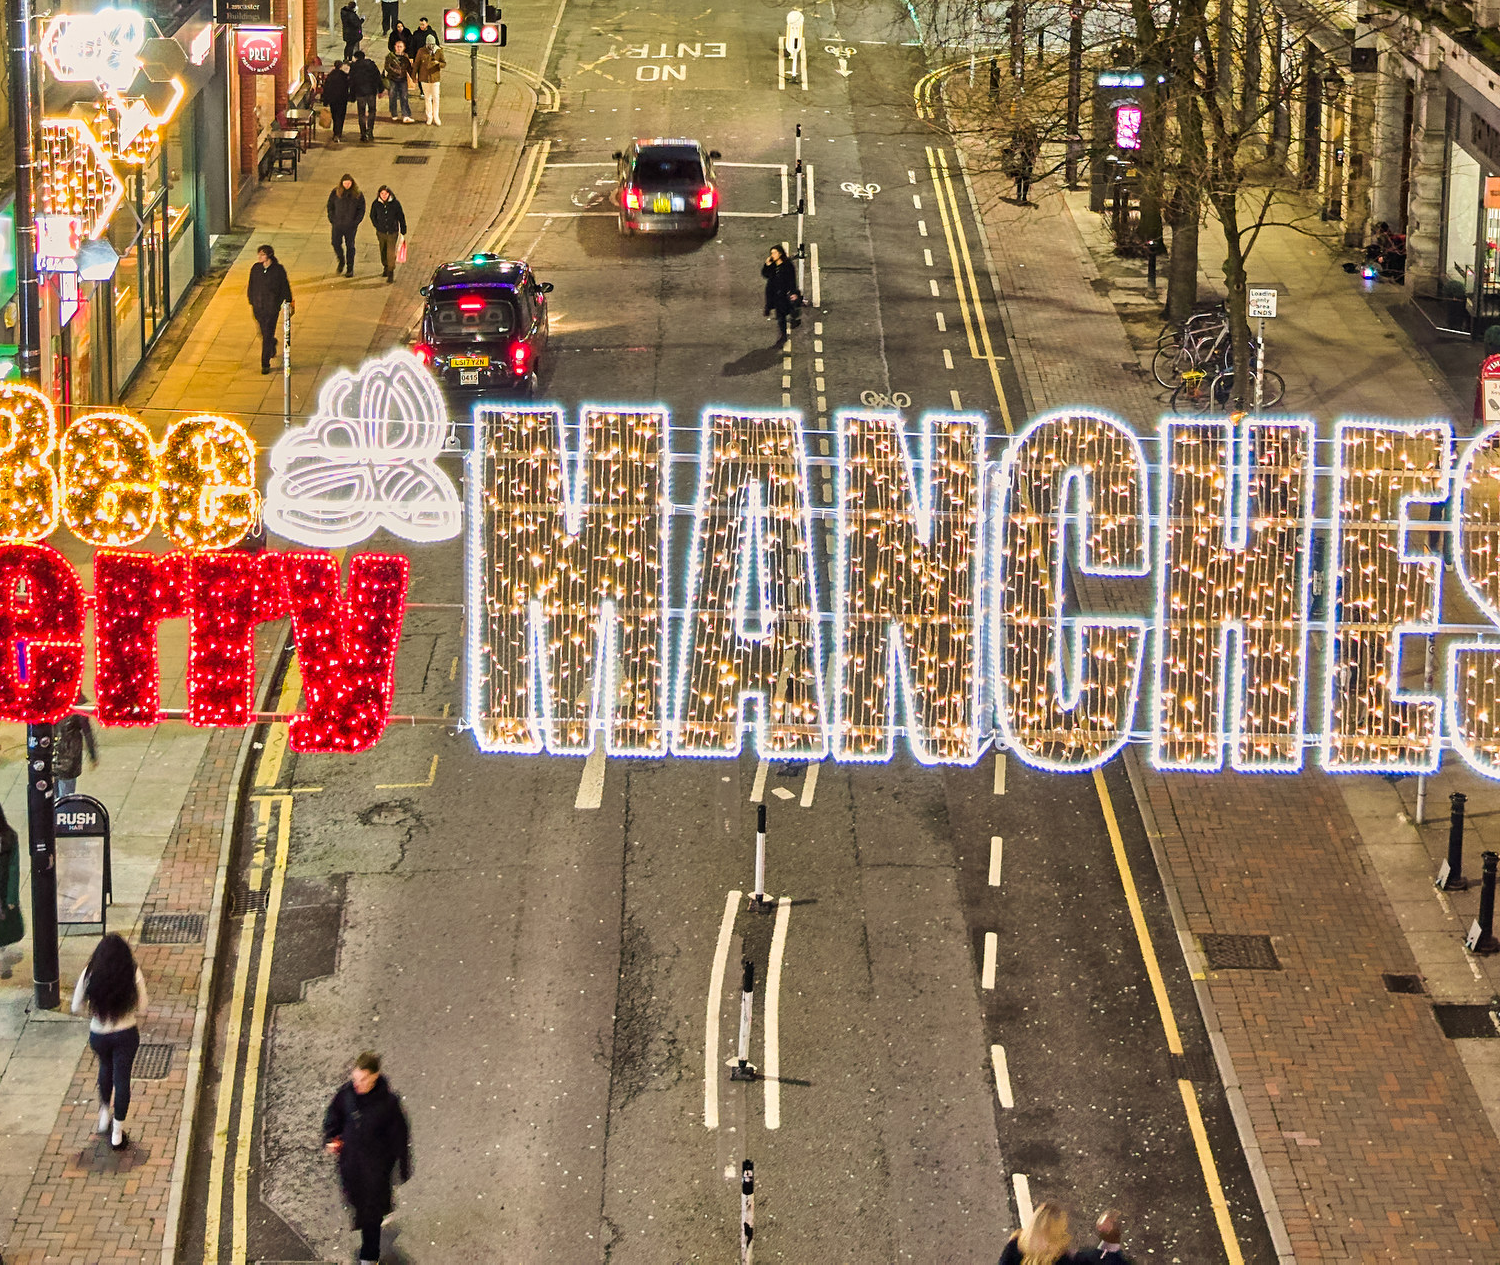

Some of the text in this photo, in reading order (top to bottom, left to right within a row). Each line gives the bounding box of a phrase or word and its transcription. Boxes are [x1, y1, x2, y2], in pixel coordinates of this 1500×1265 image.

[226, 2, 260, 10] Lancaster
[249, 47, 272, 61] PRET
[636, 65, 687, 81] NO
[1251, 290, 1276, 298] Loading
[56, 812, 97, 825] RUSH
